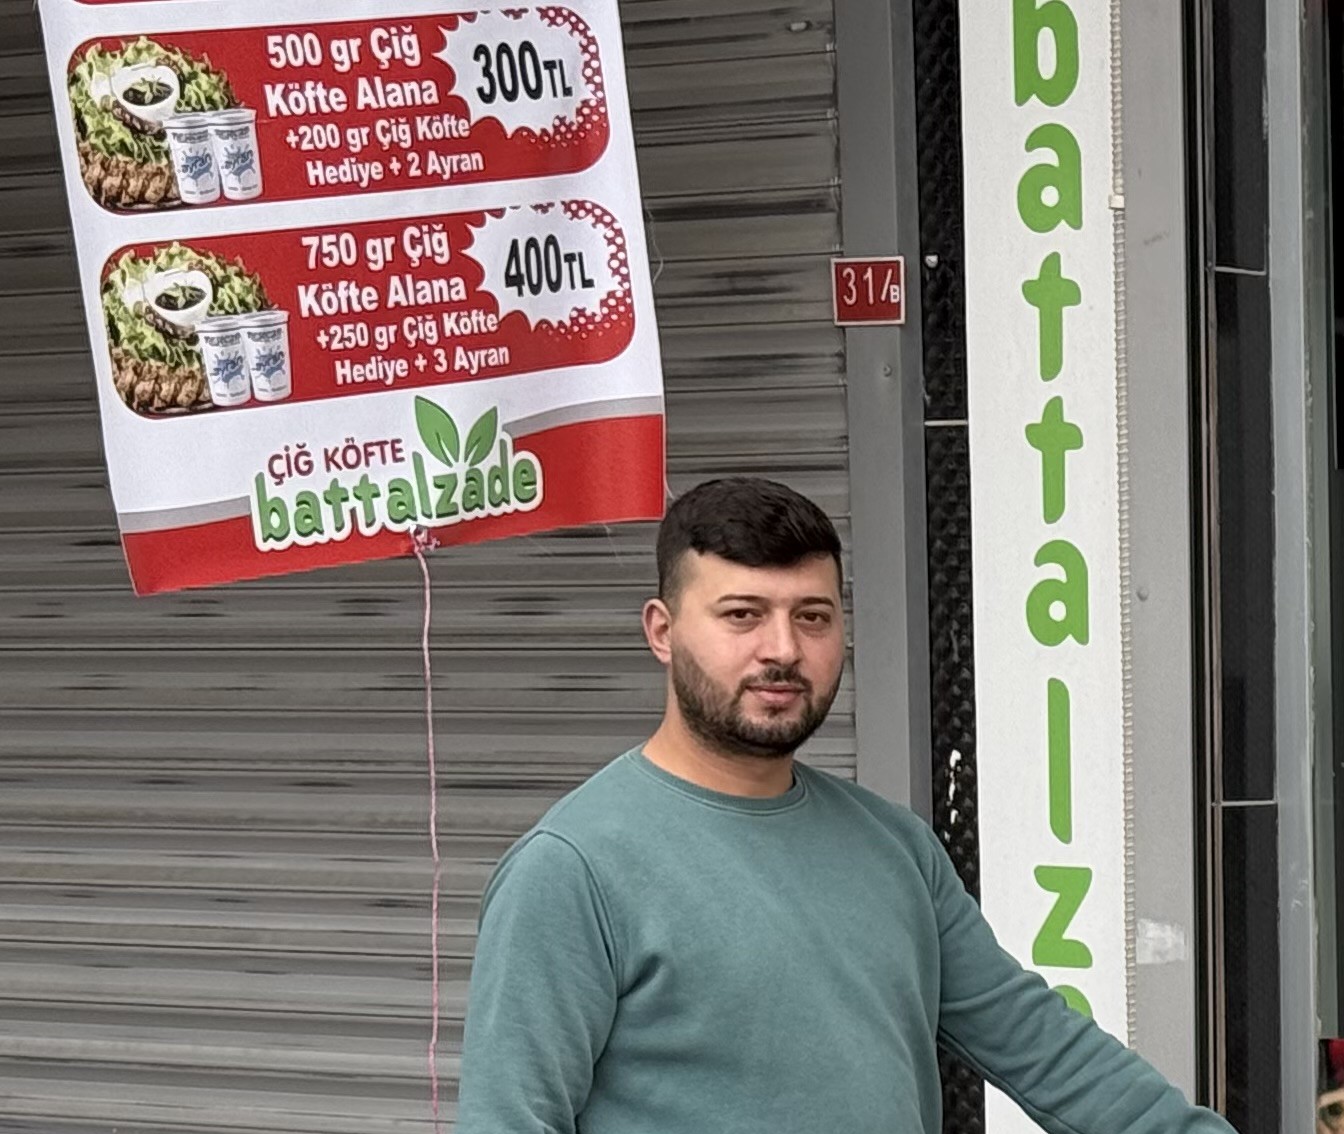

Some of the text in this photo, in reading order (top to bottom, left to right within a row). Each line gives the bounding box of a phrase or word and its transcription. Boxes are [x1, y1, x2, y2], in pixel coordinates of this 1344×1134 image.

[267, 27, 422, 71] 500 gr Çiğ
[474, 40, 572, 104] 300 TL
[264, 79, 439, 119] Köfte Alana
[287, 117, 470, 153] +200 gr Çiğ Köfte
[306, 148, 484, 187] Hediye + 2 Ayran
[302, 224, 451, 271] 750 gr Çiğ
[504, 235, 594, 296] 400 TL
[298, 278, 466, 317] Köfte Alana
[317, 313, 498, 352] +250 gr Çiğ Köfte
[335, 346, 509, 386] Hediye + 3 Ayran
[267, 434, 405, 485] ÇİĞ KÖFTE
[254, 439, 538, 544] battalzade
